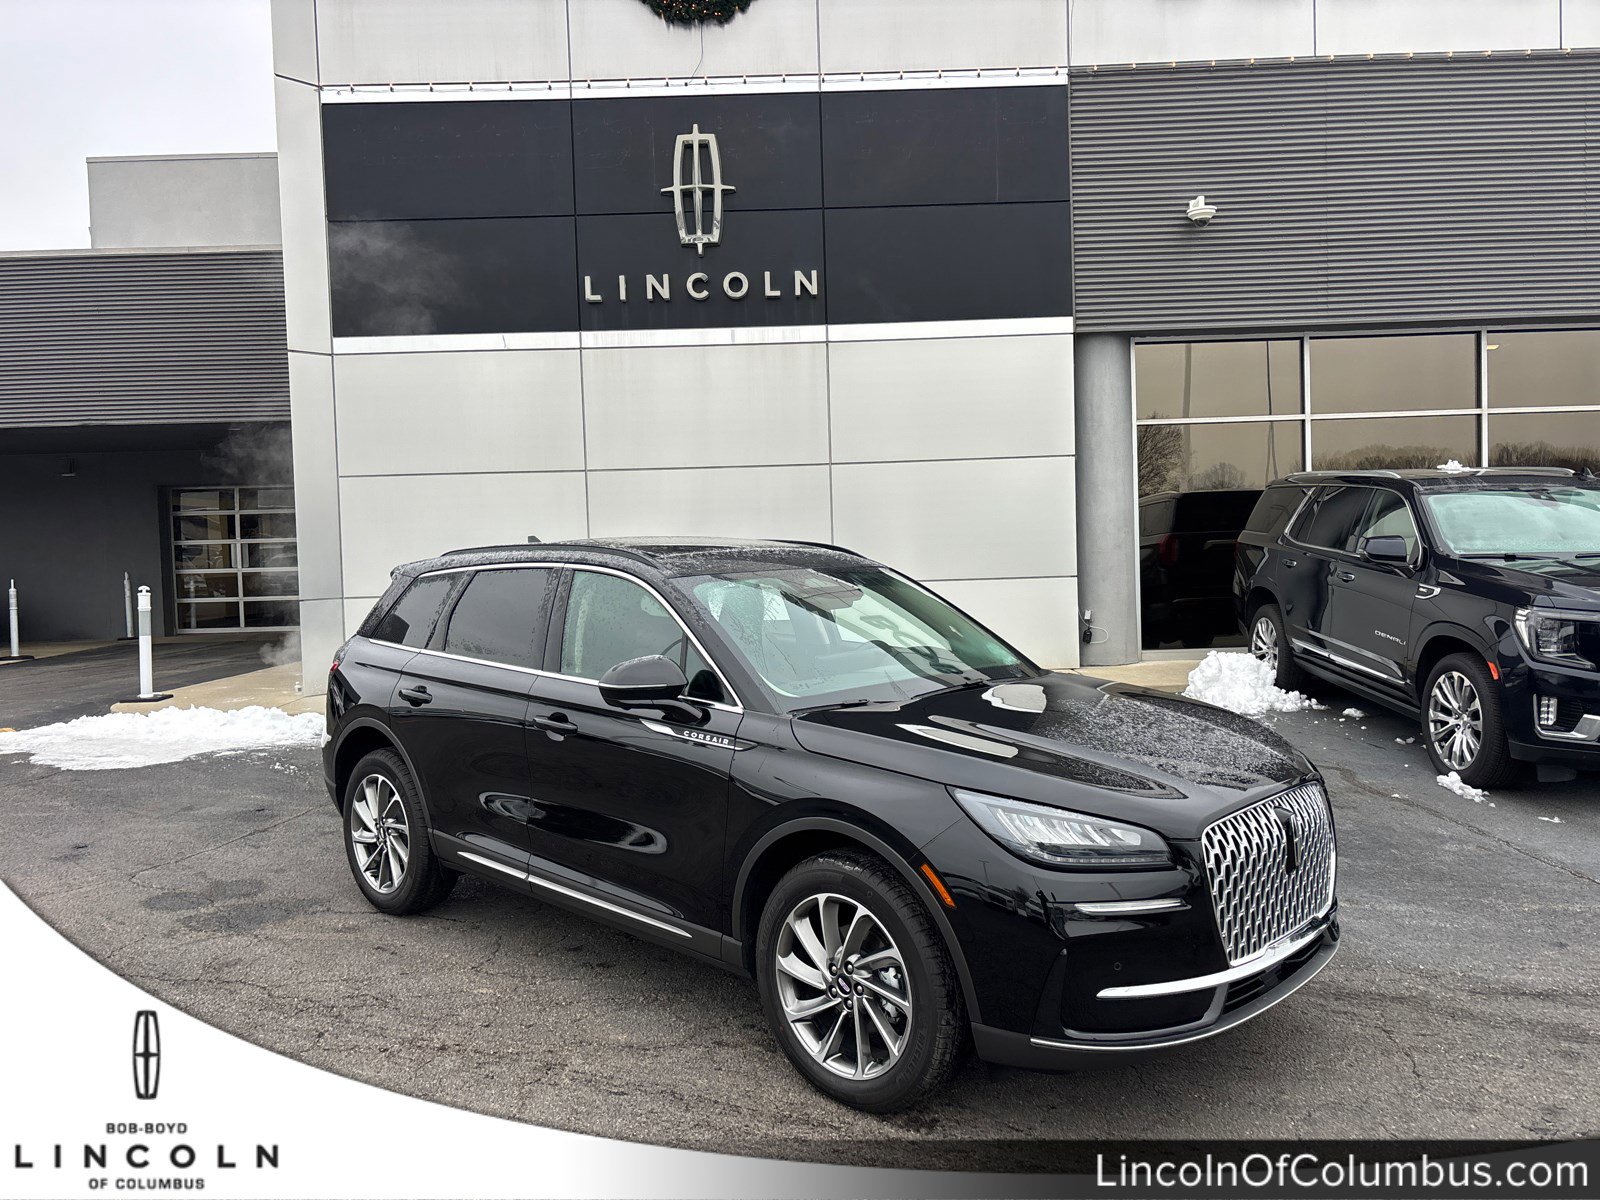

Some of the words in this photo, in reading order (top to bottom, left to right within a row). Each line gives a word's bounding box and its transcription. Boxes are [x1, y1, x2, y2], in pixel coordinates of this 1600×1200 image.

[584, 270, 818, 303] LINCOLN
[1374, 630, 1406, 646] DENALI
[683, 730, 729, 745] CORSAIR
